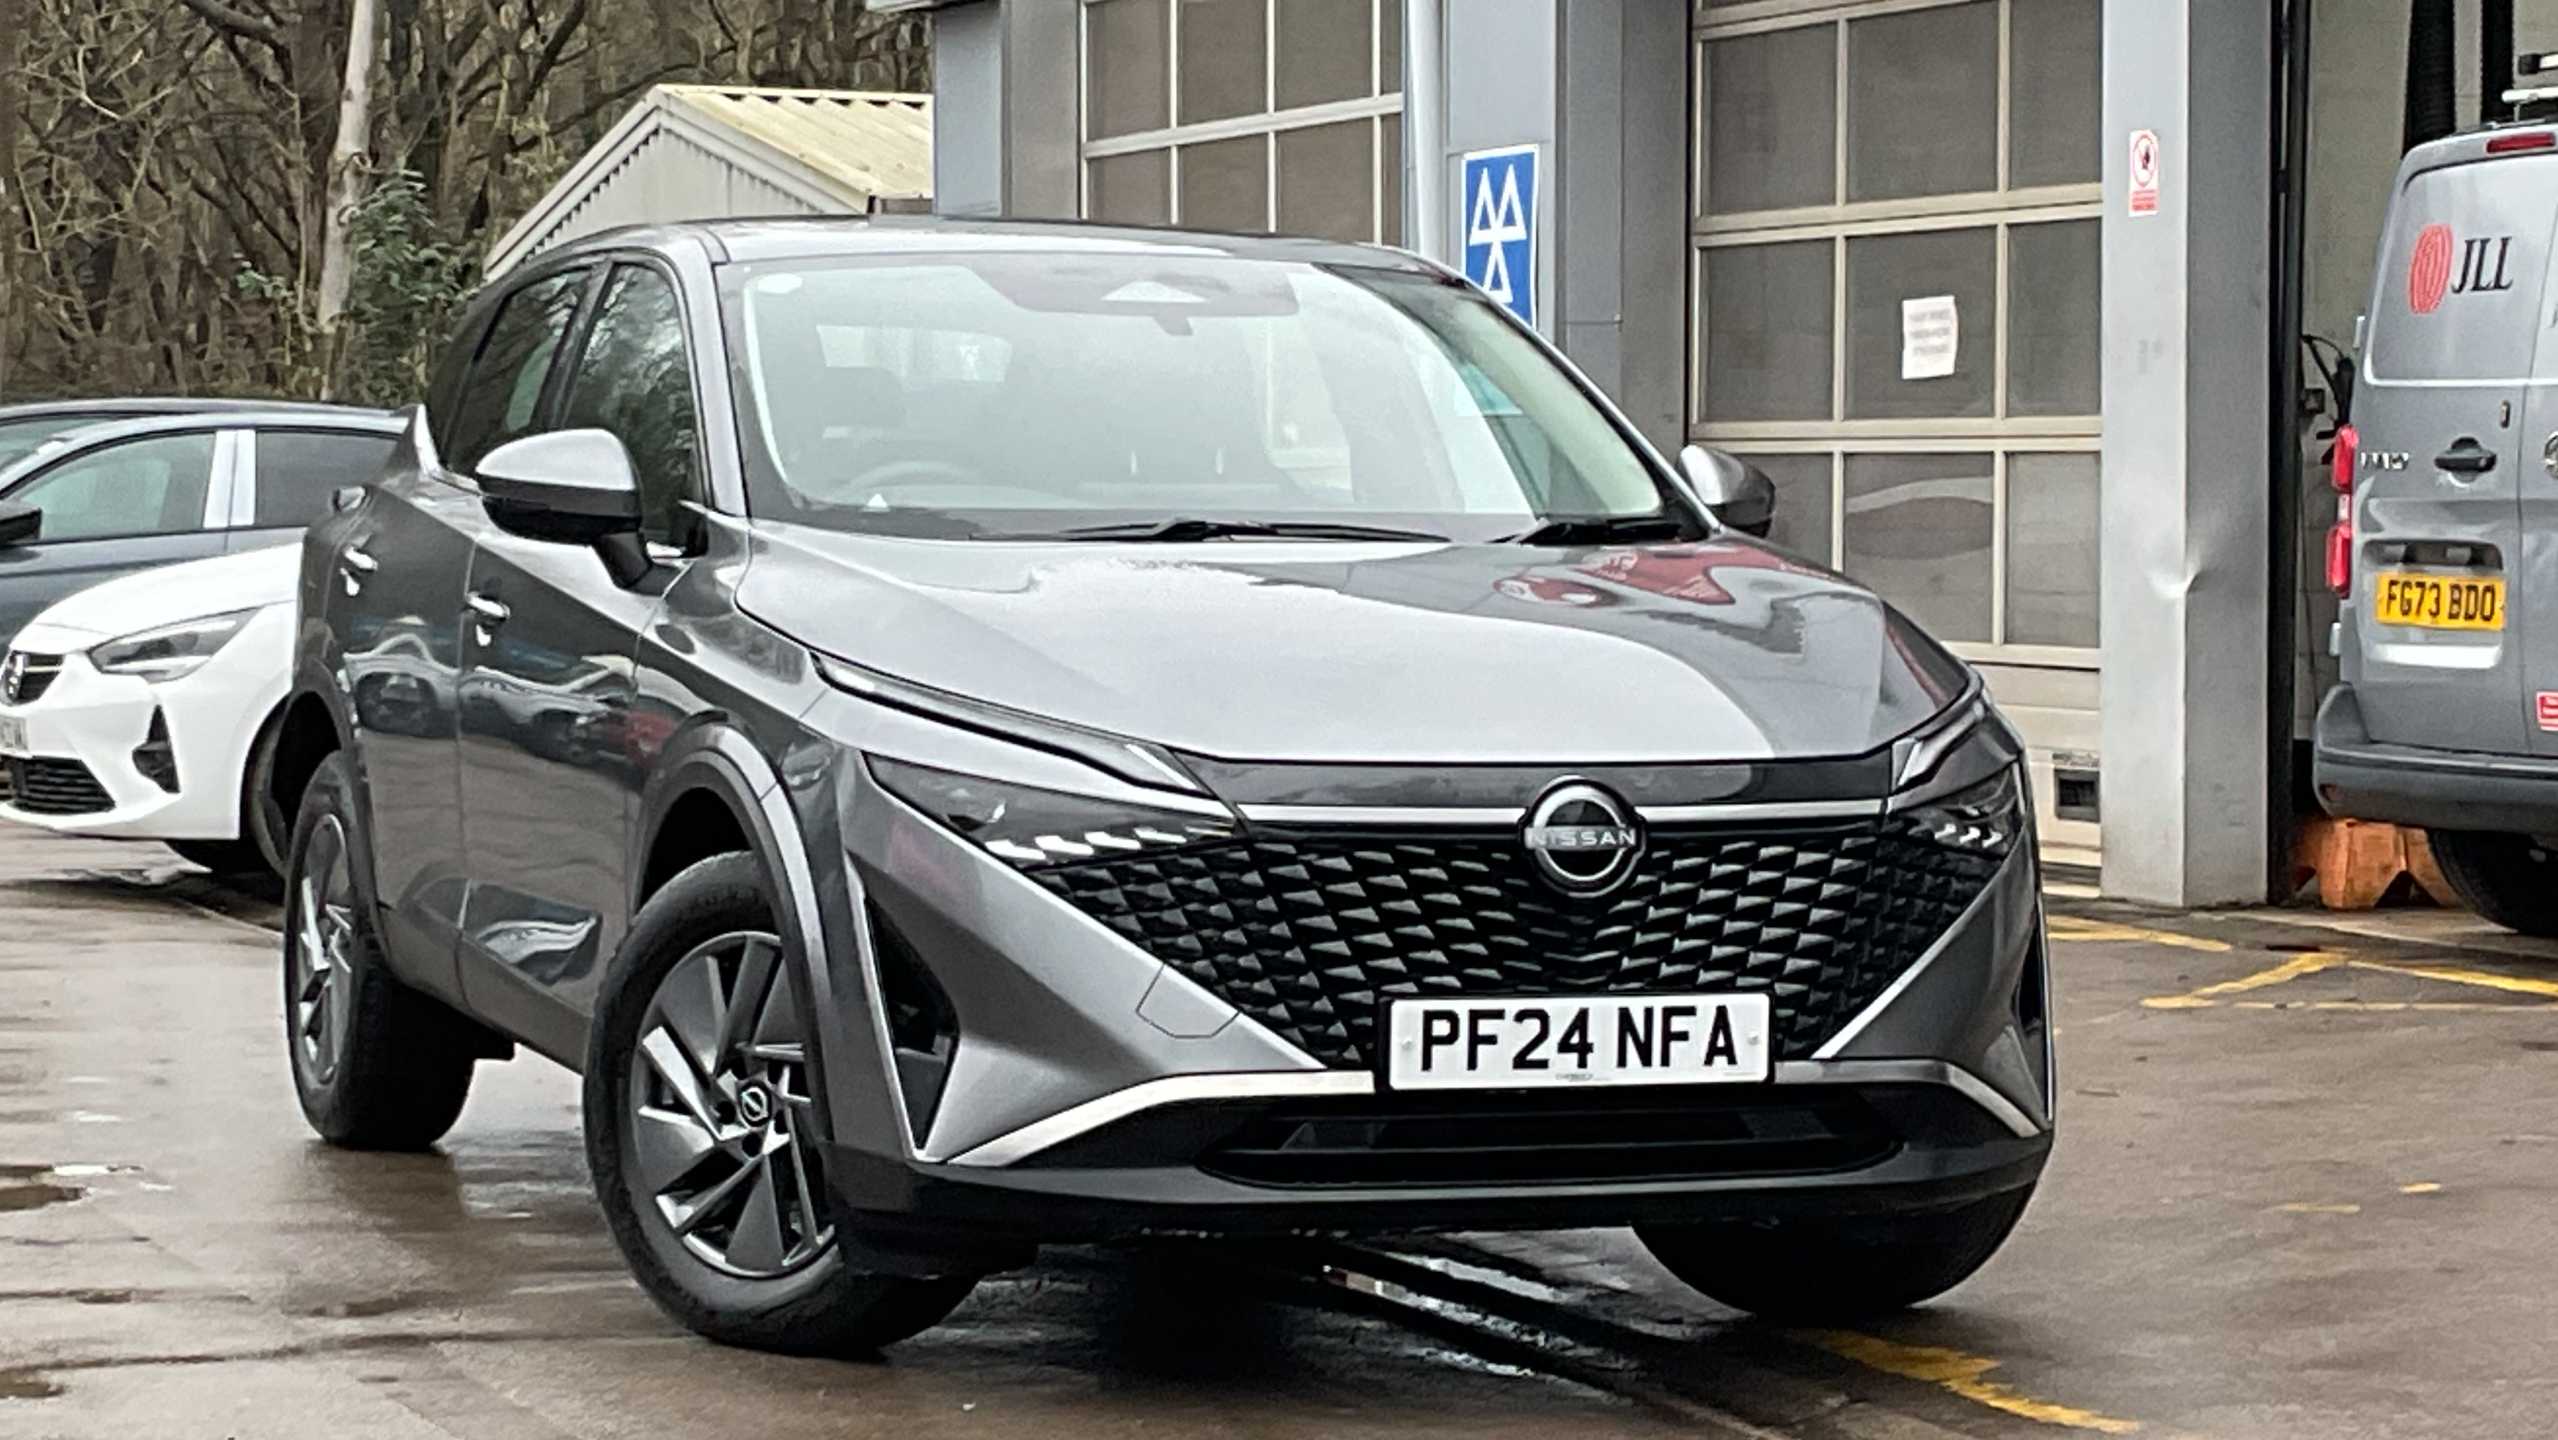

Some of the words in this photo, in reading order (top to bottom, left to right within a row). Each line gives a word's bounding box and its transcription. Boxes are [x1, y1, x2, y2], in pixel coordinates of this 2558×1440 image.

[2451, 236, 2514, 294] JLL
[2386, 579, 2440, 617] FG73
[2448, 583, 2495, 621] BDO
[1528, 829, 1636, 847] NISSAN
[1421, 1007, 1594, 1072] PF24
[1616, 1004, 1738, 1069] NFA
